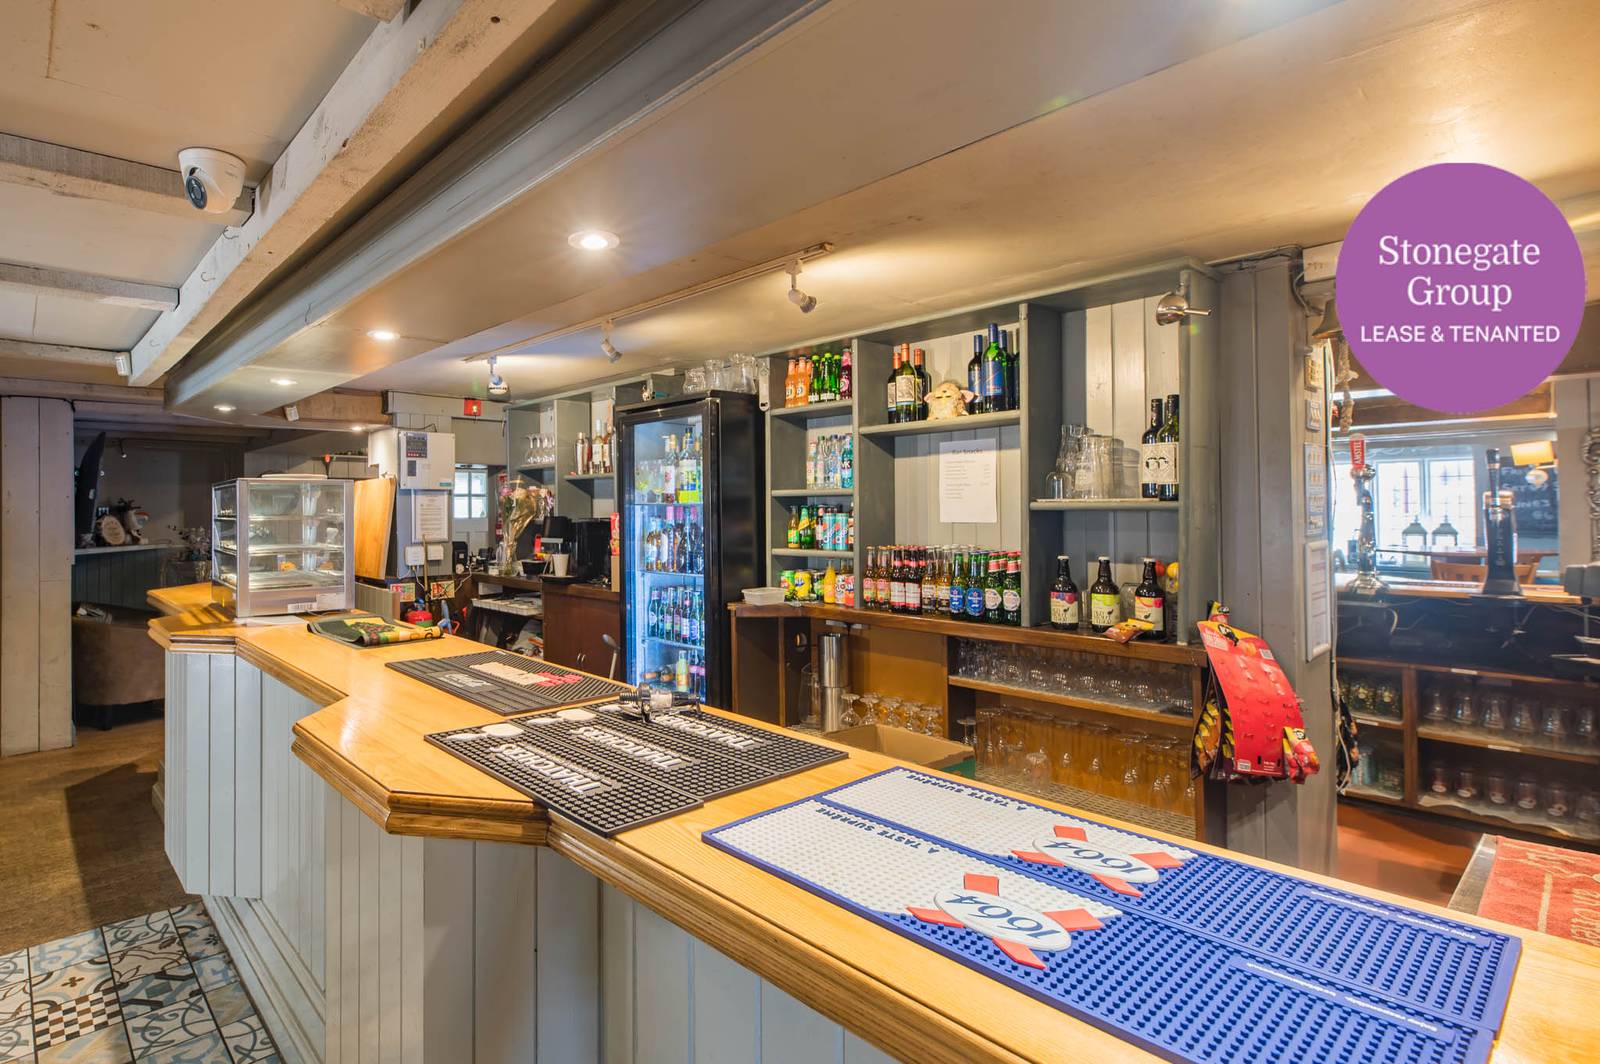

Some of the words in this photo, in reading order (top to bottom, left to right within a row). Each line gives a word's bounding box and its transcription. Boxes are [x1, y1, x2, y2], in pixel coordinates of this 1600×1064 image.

[967, 791, 1009, 807] TASTE
[876, 829, 922, 849] TASTE
[1043, 839, 1151, 874] 1664
[944, 891, 1061, 940] 1664
